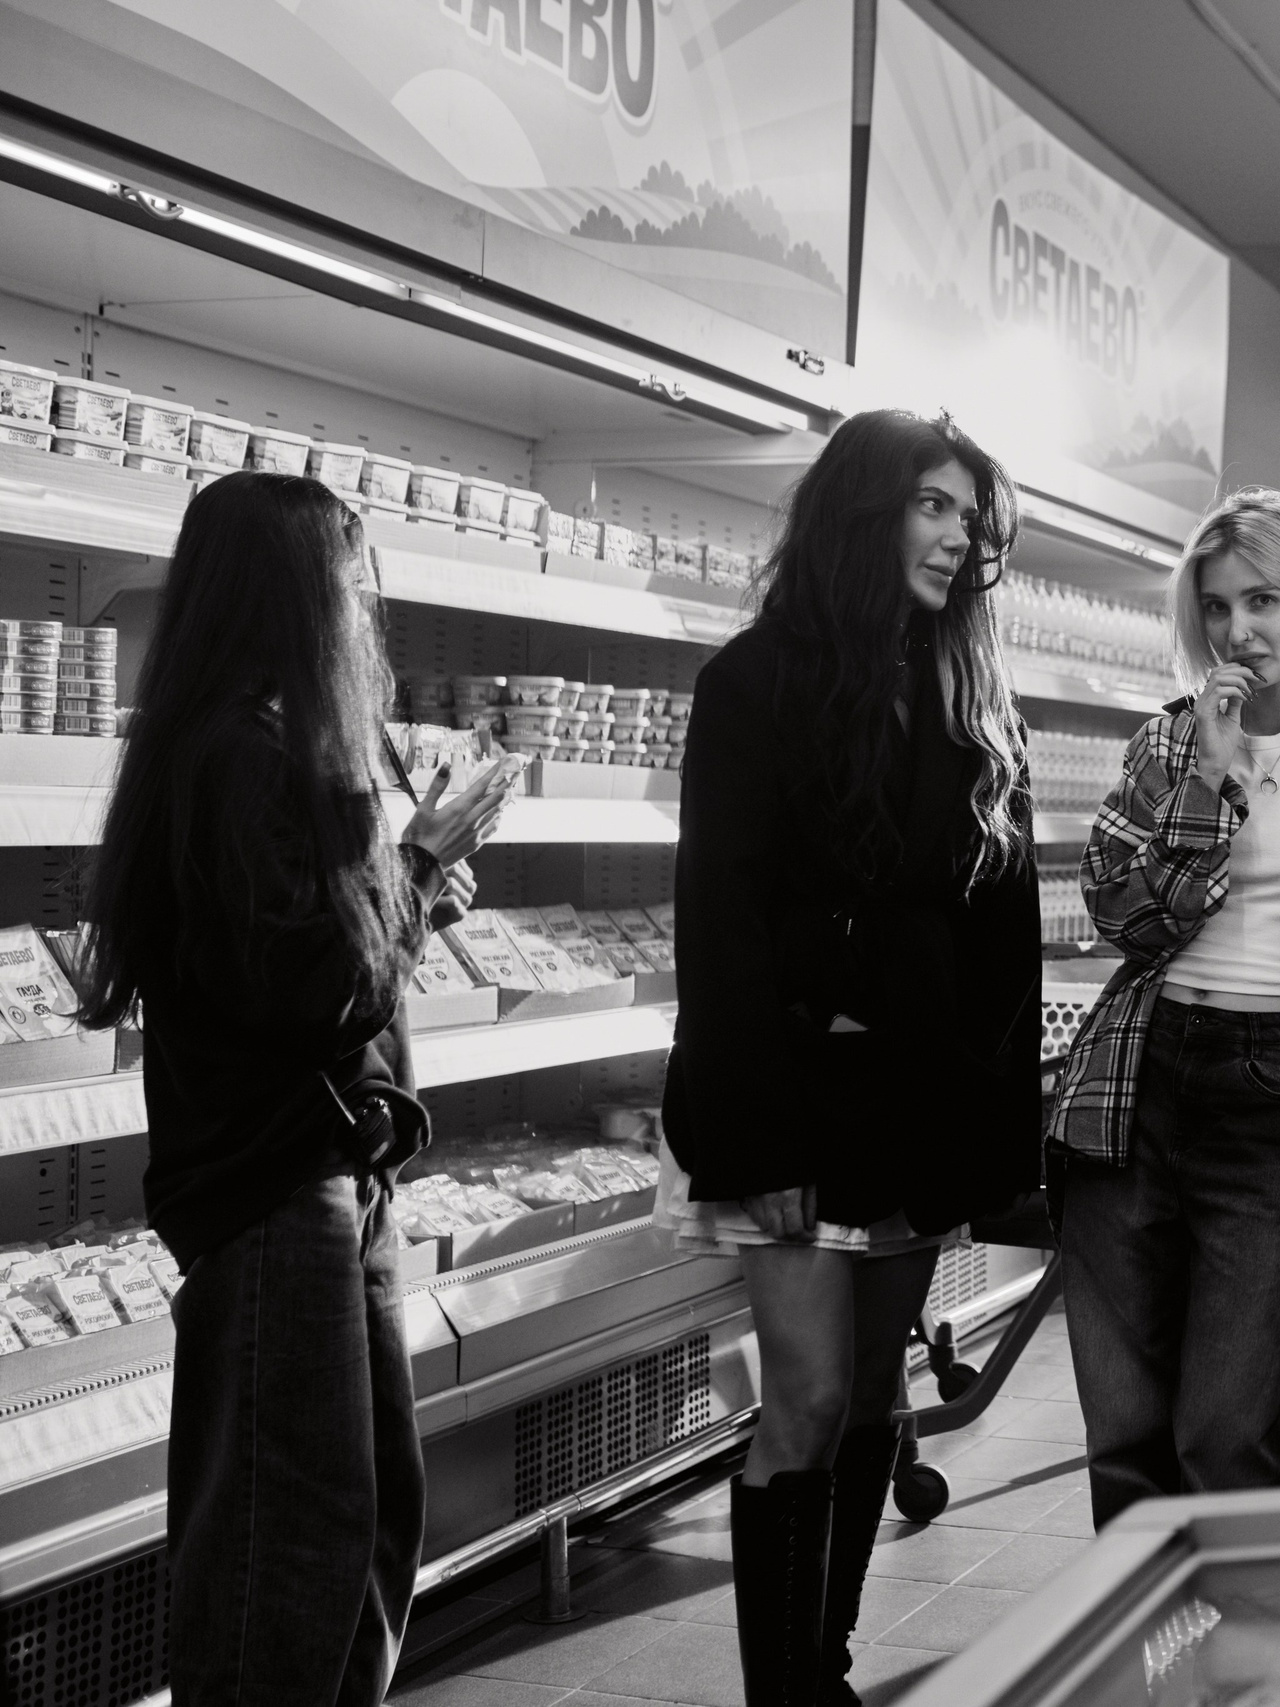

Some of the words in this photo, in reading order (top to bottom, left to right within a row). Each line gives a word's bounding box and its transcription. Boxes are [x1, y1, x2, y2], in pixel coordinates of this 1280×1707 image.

[990, 198, 1138, 386] СВЕТАЕВО
[16, 984, 44, 998] ГАУДА
[123, 1277, 154, 1295] СВЕТАЕВО
[72, 1290, 106, 1306] СВЕТАЕВО
[15, 1304, 53, 1321] СВЕТАЕВО
